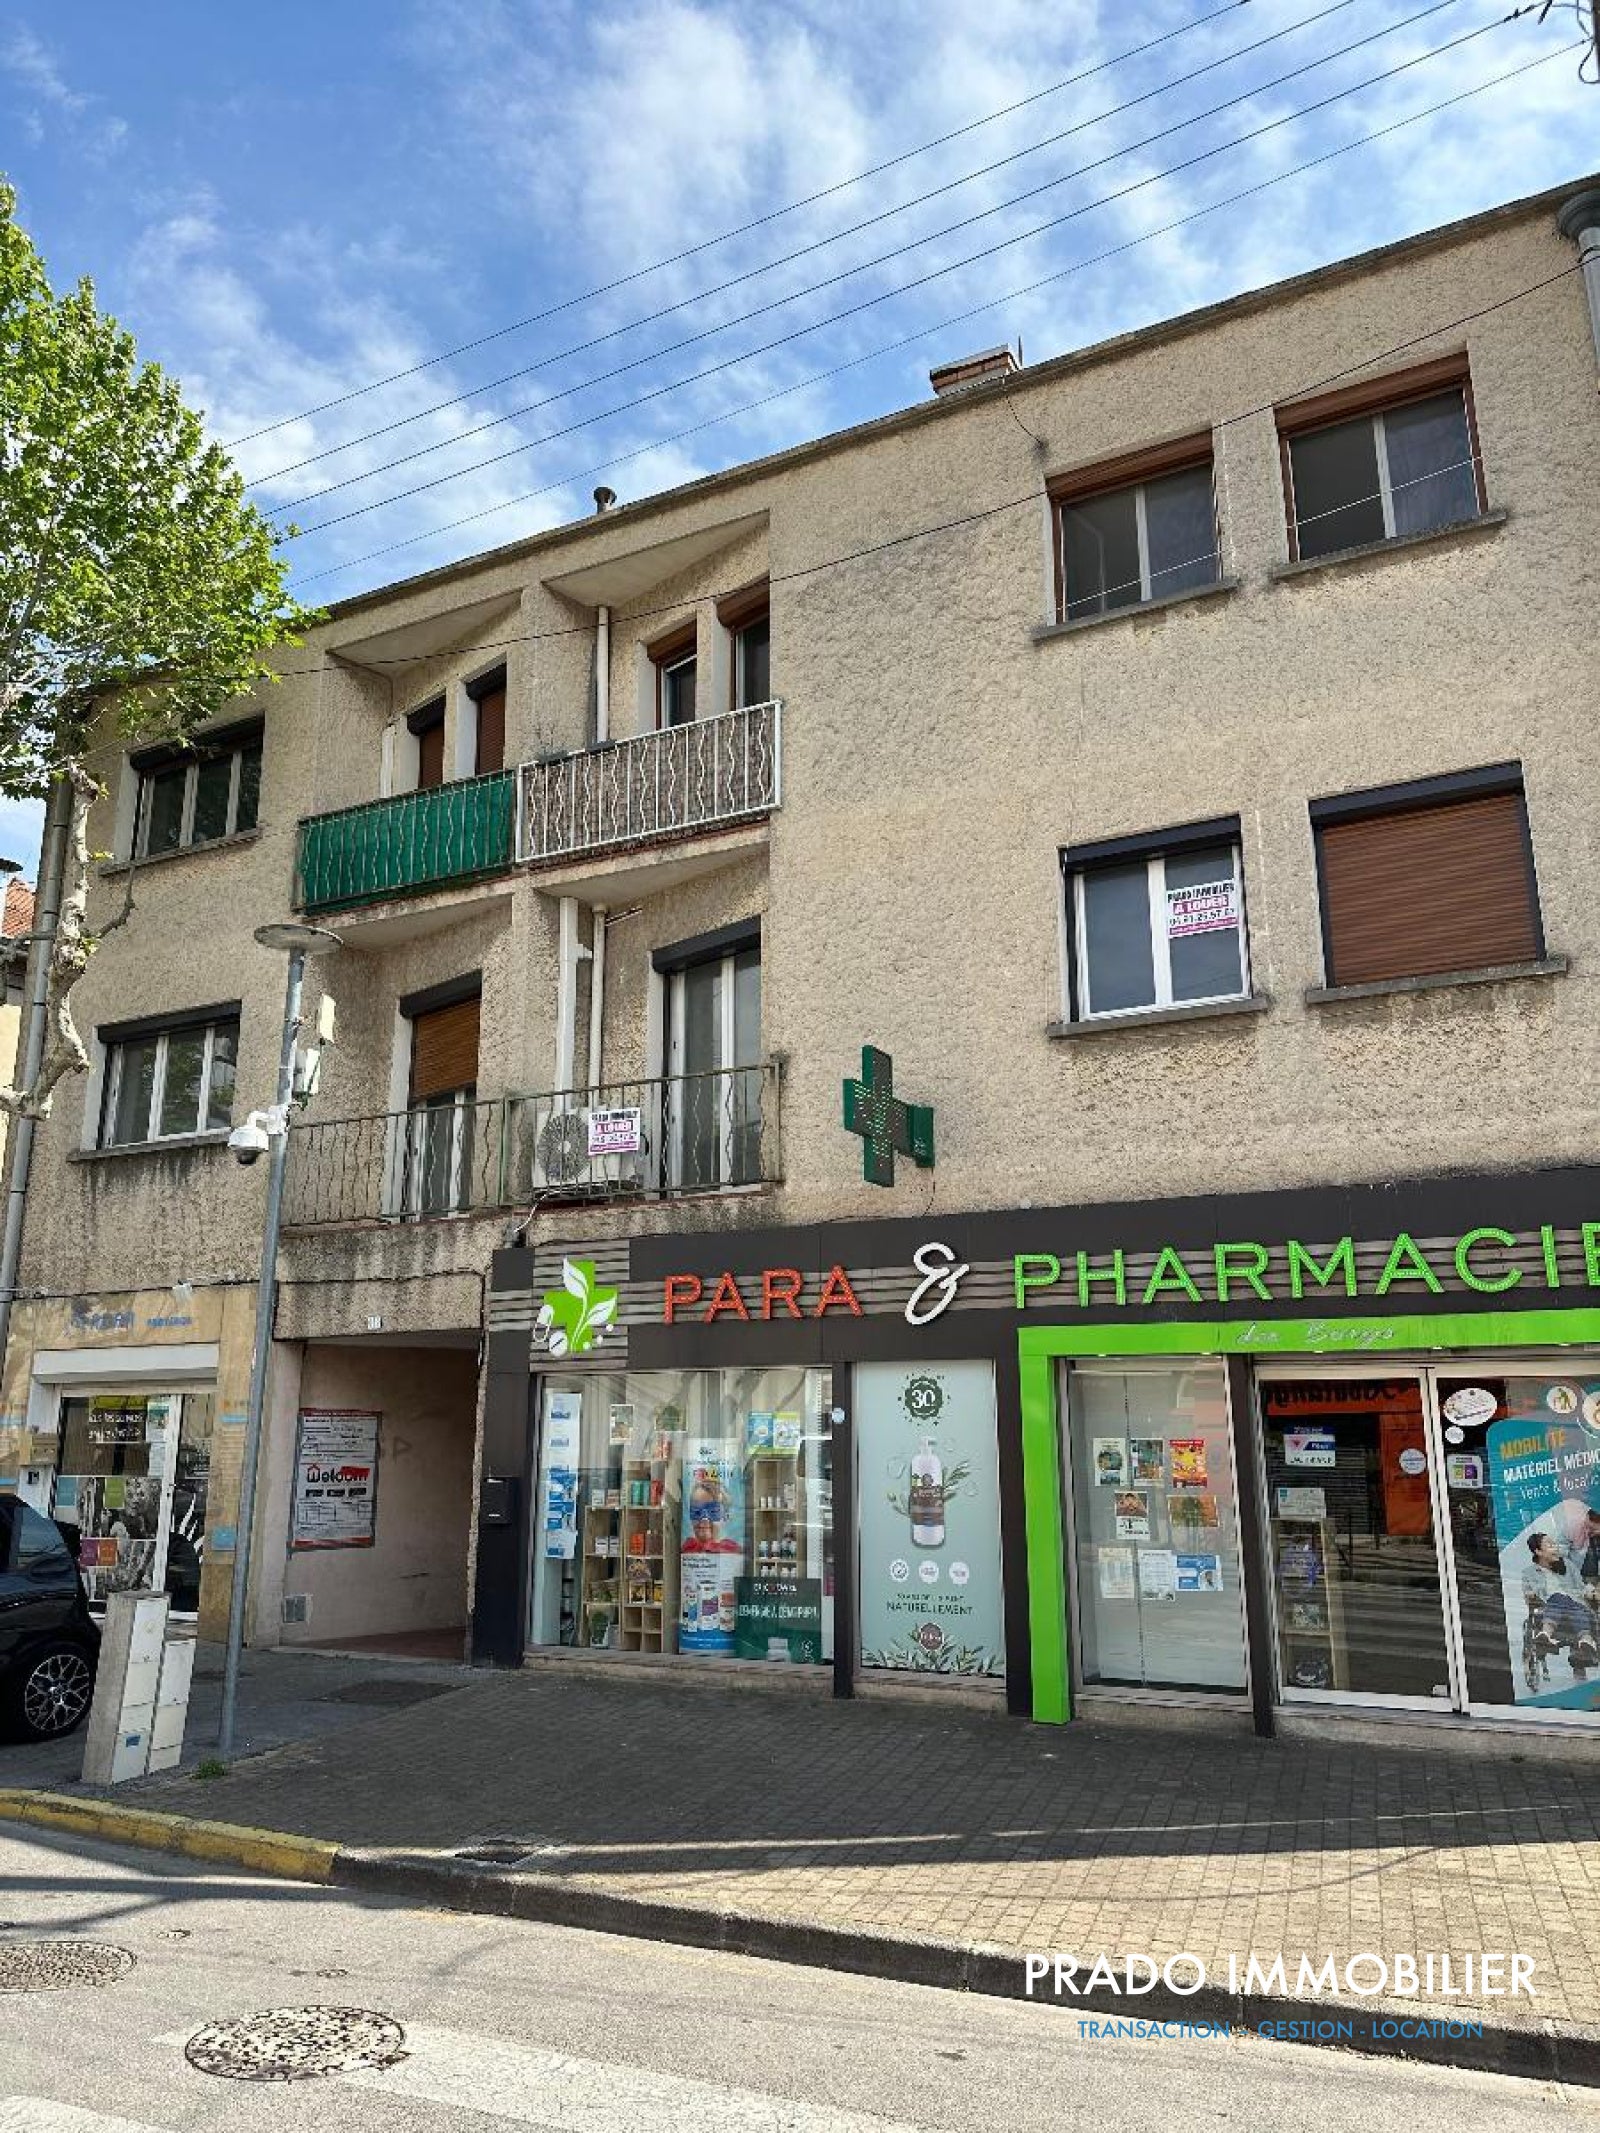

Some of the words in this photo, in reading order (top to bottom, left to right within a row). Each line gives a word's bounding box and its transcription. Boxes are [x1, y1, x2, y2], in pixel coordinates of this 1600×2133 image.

[664, 1264, 863, 1325] PARA
[904, 1242, 969, 1325] &
[911, 1389, 936, 1409] 30
[1503, 1459, 1563, 1484] MATÉRIEL
[1520, 1482, 1549, 1499] Vente
[887, 1601, 973, 1615] NATURELLEMENT
